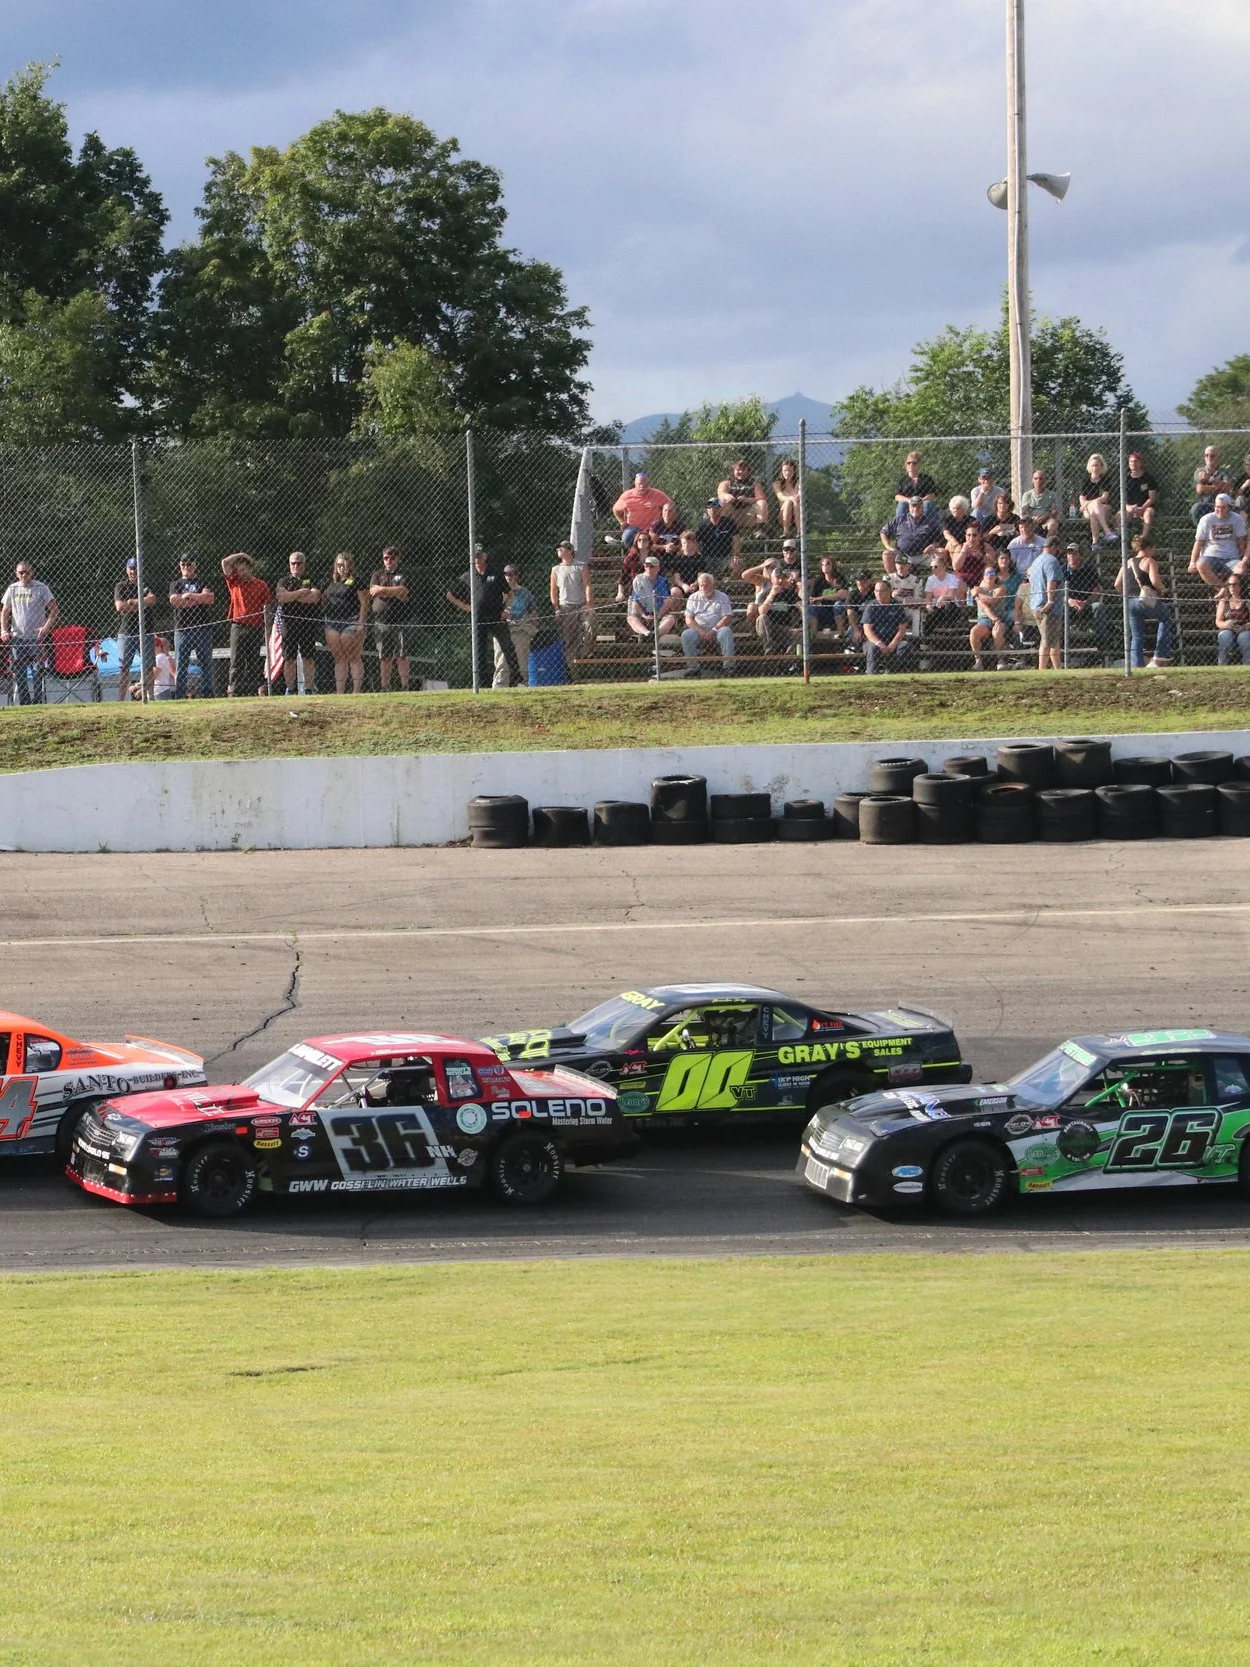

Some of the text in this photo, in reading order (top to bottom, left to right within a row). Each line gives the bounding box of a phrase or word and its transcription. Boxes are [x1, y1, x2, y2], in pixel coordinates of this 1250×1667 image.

[621, 991, 666, 1010] GRAY
[762, 1007, 770, 1040] CHEVY
[777, 1037, 912, 1065] GRAY'S EQUIPMENT
[873, 1047, 903, 1057] SALES
[61, 1073, 132, 1099] SANTO
[655, 1051, 755, 1112] 00
[730, 1085, 757, 1100] VT
[979, 1096, 1008, 1106] EMERSON
[491, 1098, 606, 1120] SOLENO
[552, 1116, 613, 1126] Mastering Storm Water
[1062, 1120, 1094, 1134] RESTAURANT
[255, 1139, 280, 1147] Bassett
[330, 1112, 436, 1171] 36
[1103, 1106, 1223, 1174] 26
[297, 1145, 309, 1158] S
[425, 1145, 457, 1158] NH
[289, 1179, 328, 1193] GWW
[388, 1177, 429, 1188] WATER
[430, 1175, 468, 1186] WELLS
